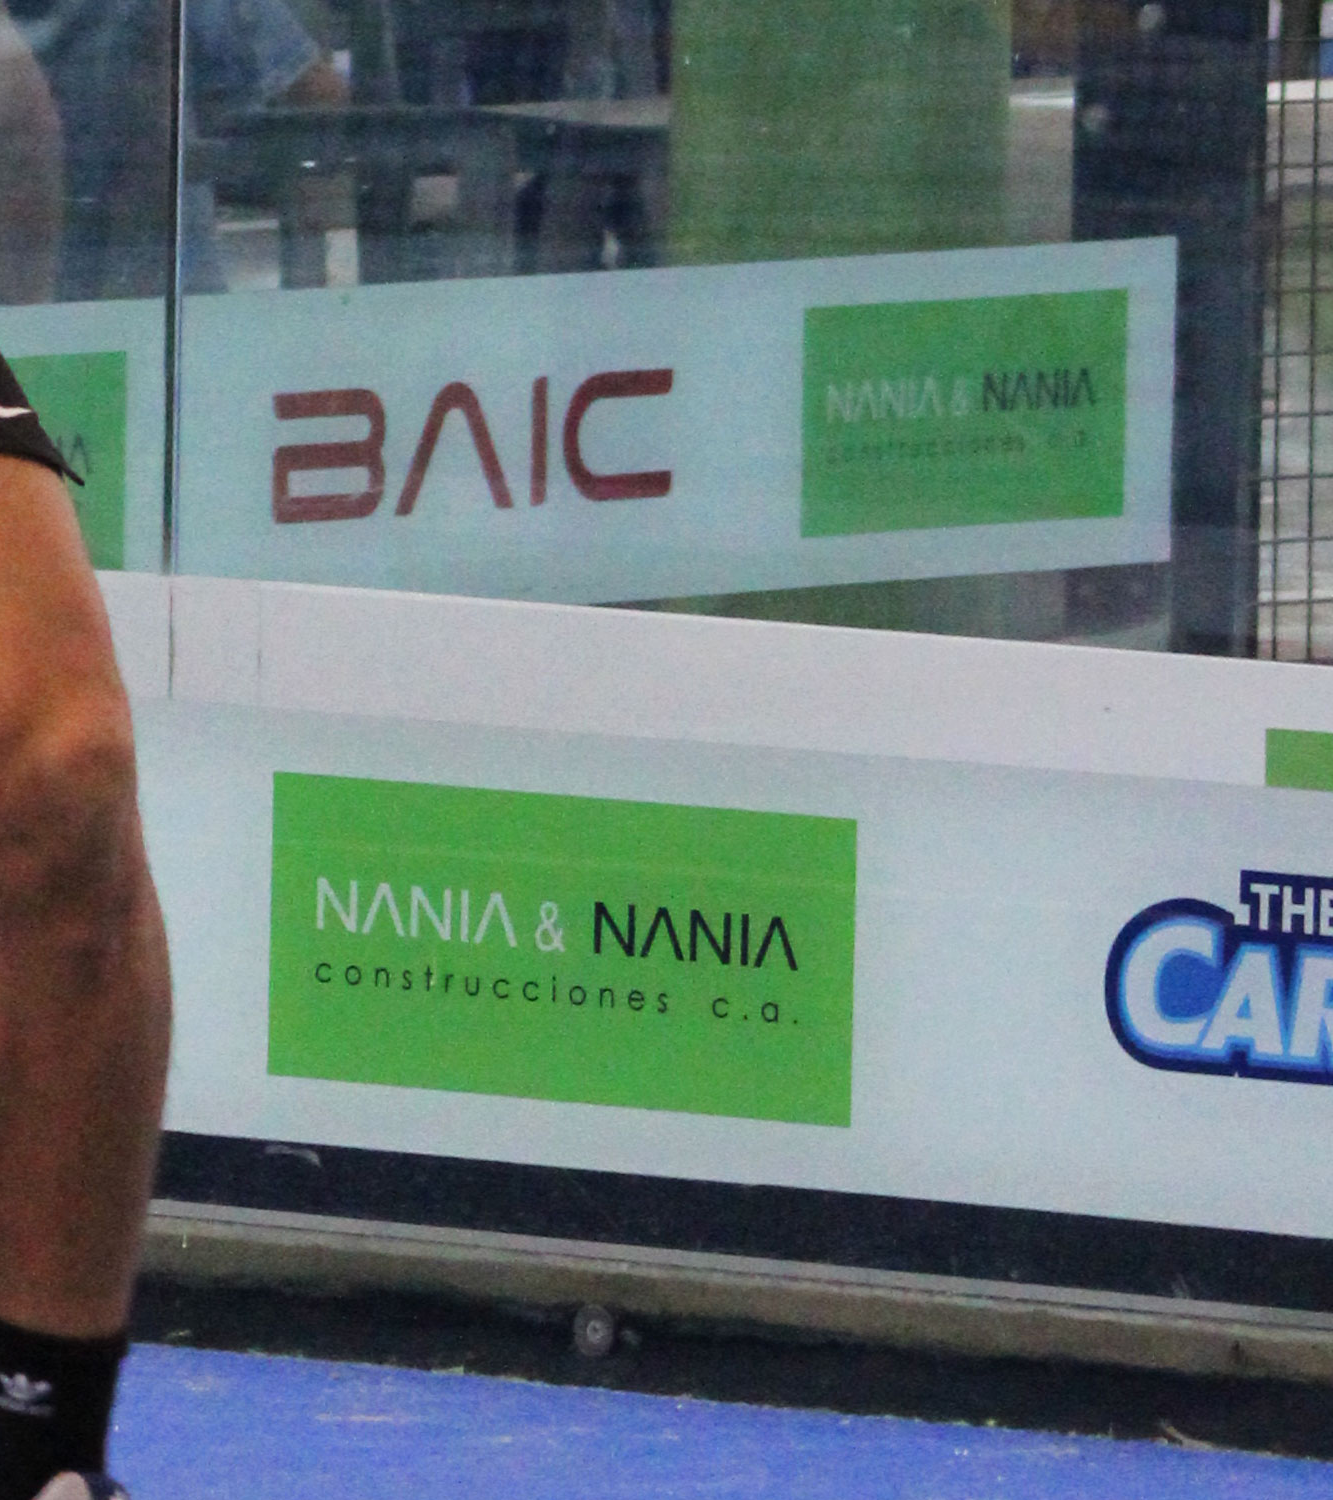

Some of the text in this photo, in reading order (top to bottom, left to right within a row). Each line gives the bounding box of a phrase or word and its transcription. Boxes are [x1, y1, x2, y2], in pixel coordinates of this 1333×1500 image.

[982, 367, 1097, 411] NANIA
[272, 369, 674, 524] BAIC
[316, 876, 799, 972] NANIA & NANIA
[1249, 882, 1333, 938] THE
[315, 961, 799, 1025] construcciones c.a.
